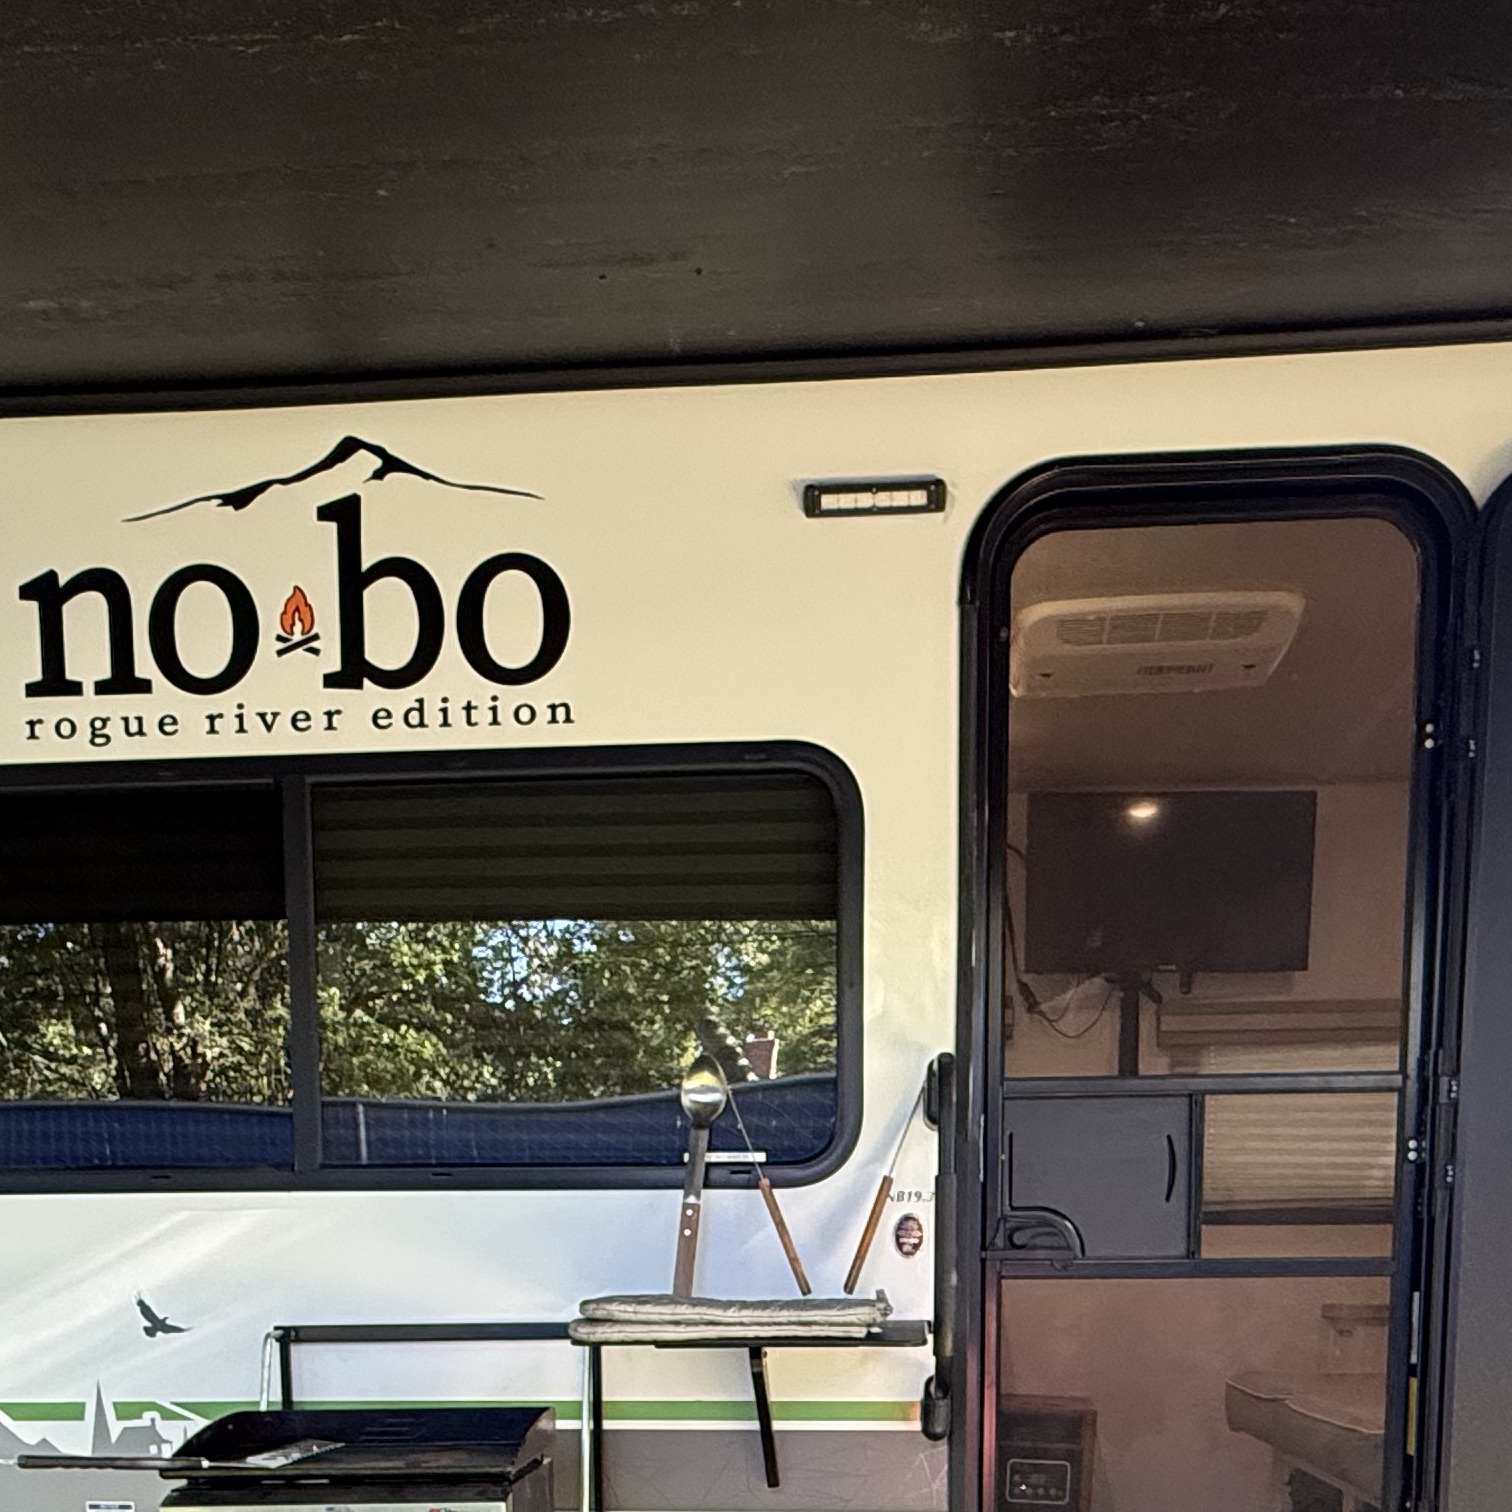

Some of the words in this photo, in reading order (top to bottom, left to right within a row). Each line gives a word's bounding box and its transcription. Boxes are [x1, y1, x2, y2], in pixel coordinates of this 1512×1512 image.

[25, 714, 179, 747] rogue
[205, 703, 342, 735] river
[371, 695, 575, 730] edition
